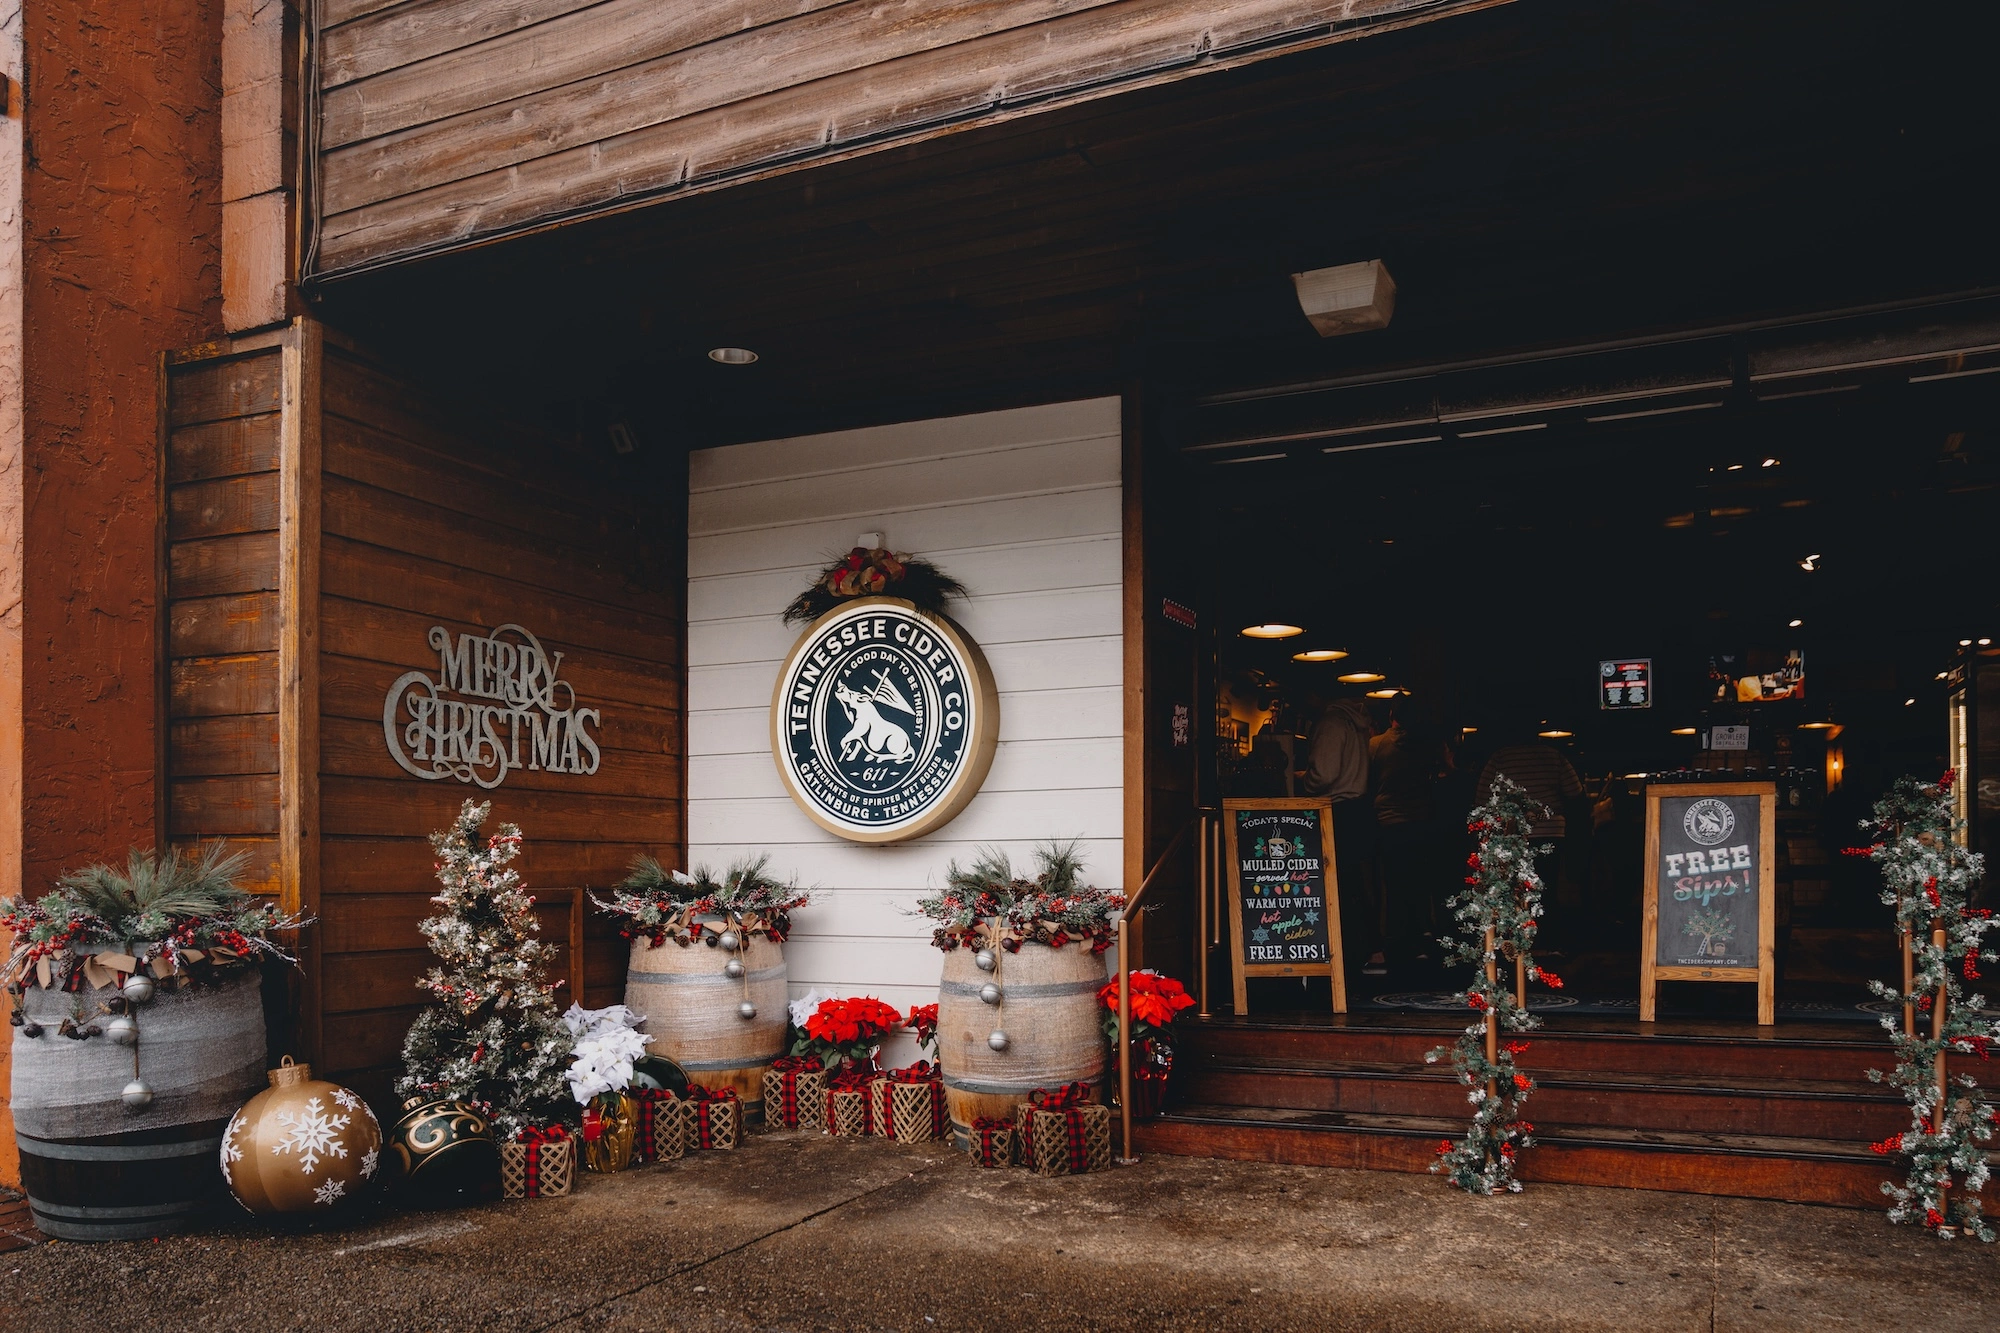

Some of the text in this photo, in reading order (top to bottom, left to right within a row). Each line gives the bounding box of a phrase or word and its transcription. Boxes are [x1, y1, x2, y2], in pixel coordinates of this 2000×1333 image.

[428, 623, 575, 717] MERRY
[791, 619, 963, 738] TENNESSEE CIDER CO.
[844, 651, 924, 738] A GOOD DAY TO BE THIRSTY
[382, 671, 601, 790] CHRISTMAS
[1715, 733, 1746, 741] GROWLERS
[809, 755, 942, 806] MERCHANTS OF SPIRITED WET GOODS
[862, 766, 889, 782] 611
[800, 762, 870, 820] GATLINBURG
[883, 759, 953, 819] TENNESSEE
[1685, 800, 1713, 826] TENNESSEE
[1714, 801, 1731, 816] CIDER
[1241, 816, 1315, 830] TODAY'S SPECIAL
[1242, 858, 1320, 872] MULLED CIDER
[1665, 844, 1752, 878] FREE
[1254, 871, 1310, 883] served hot
[1245, 896, 1321, 909] WARM UP WITH
[1260, 909, 1282, 924] hot
[1270, 914, 1303, 935] apple
[1284, 927, 1316, 941] cider
[1249, 945, 1283, 960] FREE
[1677, 958, 1738, 966] TNCIDERCOMPANY.COM
